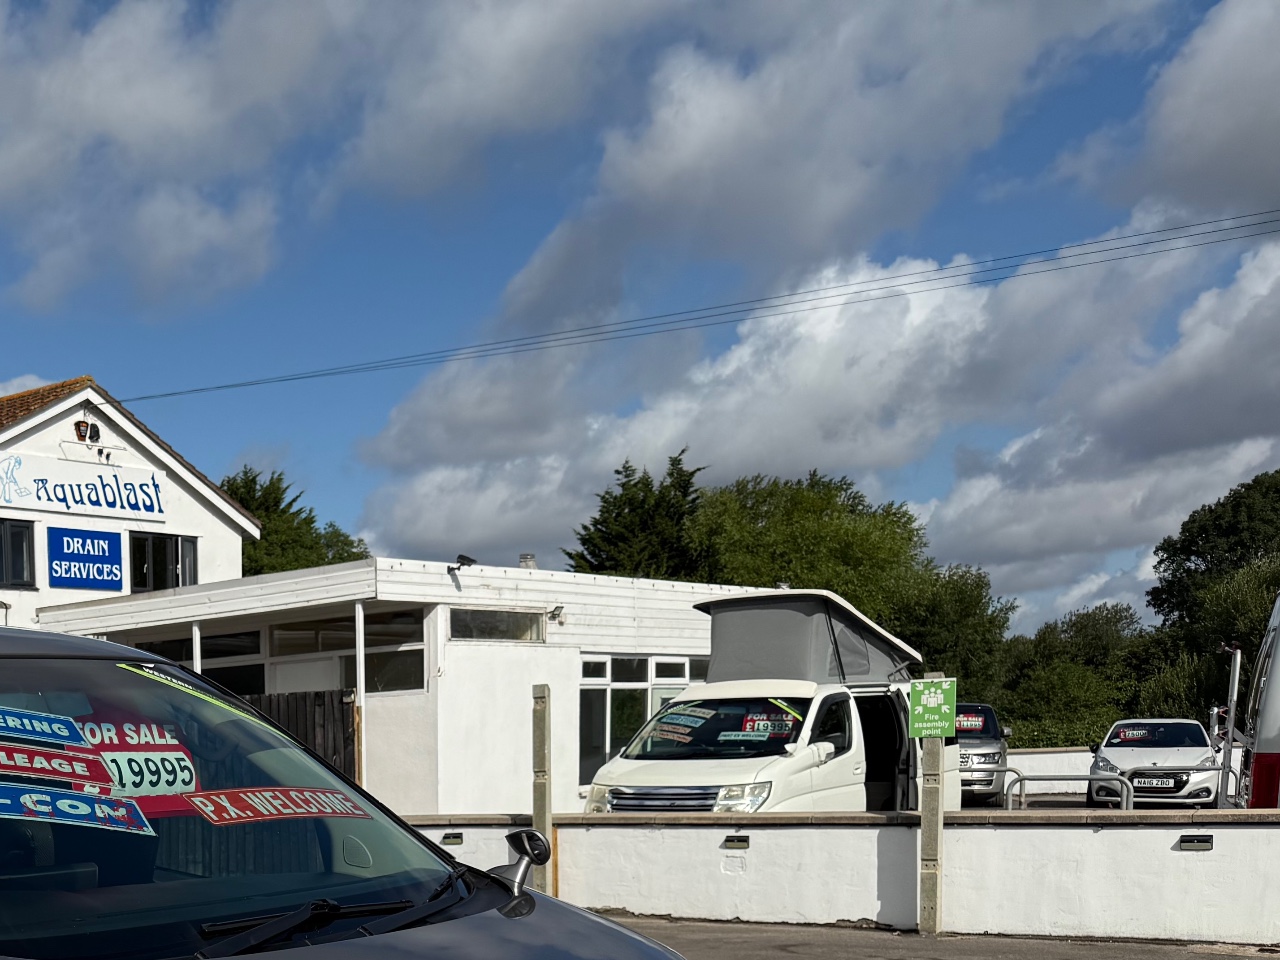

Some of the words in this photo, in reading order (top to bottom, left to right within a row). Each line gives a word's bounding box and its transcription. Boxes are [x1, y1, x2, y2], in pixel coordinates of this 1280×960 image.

[33, 472, 164, 514] Aquablast
[63, 537, 109, 556] DRAIN
[52, 560, 121, 581] SERVICES
[914, 720, 950, 729] assembly
[924, 713, 940, 721] Fire
[122, 722, 179, 745] SALE
[922, 728, 942, 736] point
[190, 794, 254, 821] P.X.
[238, 791, 366, 815] WELCOME
